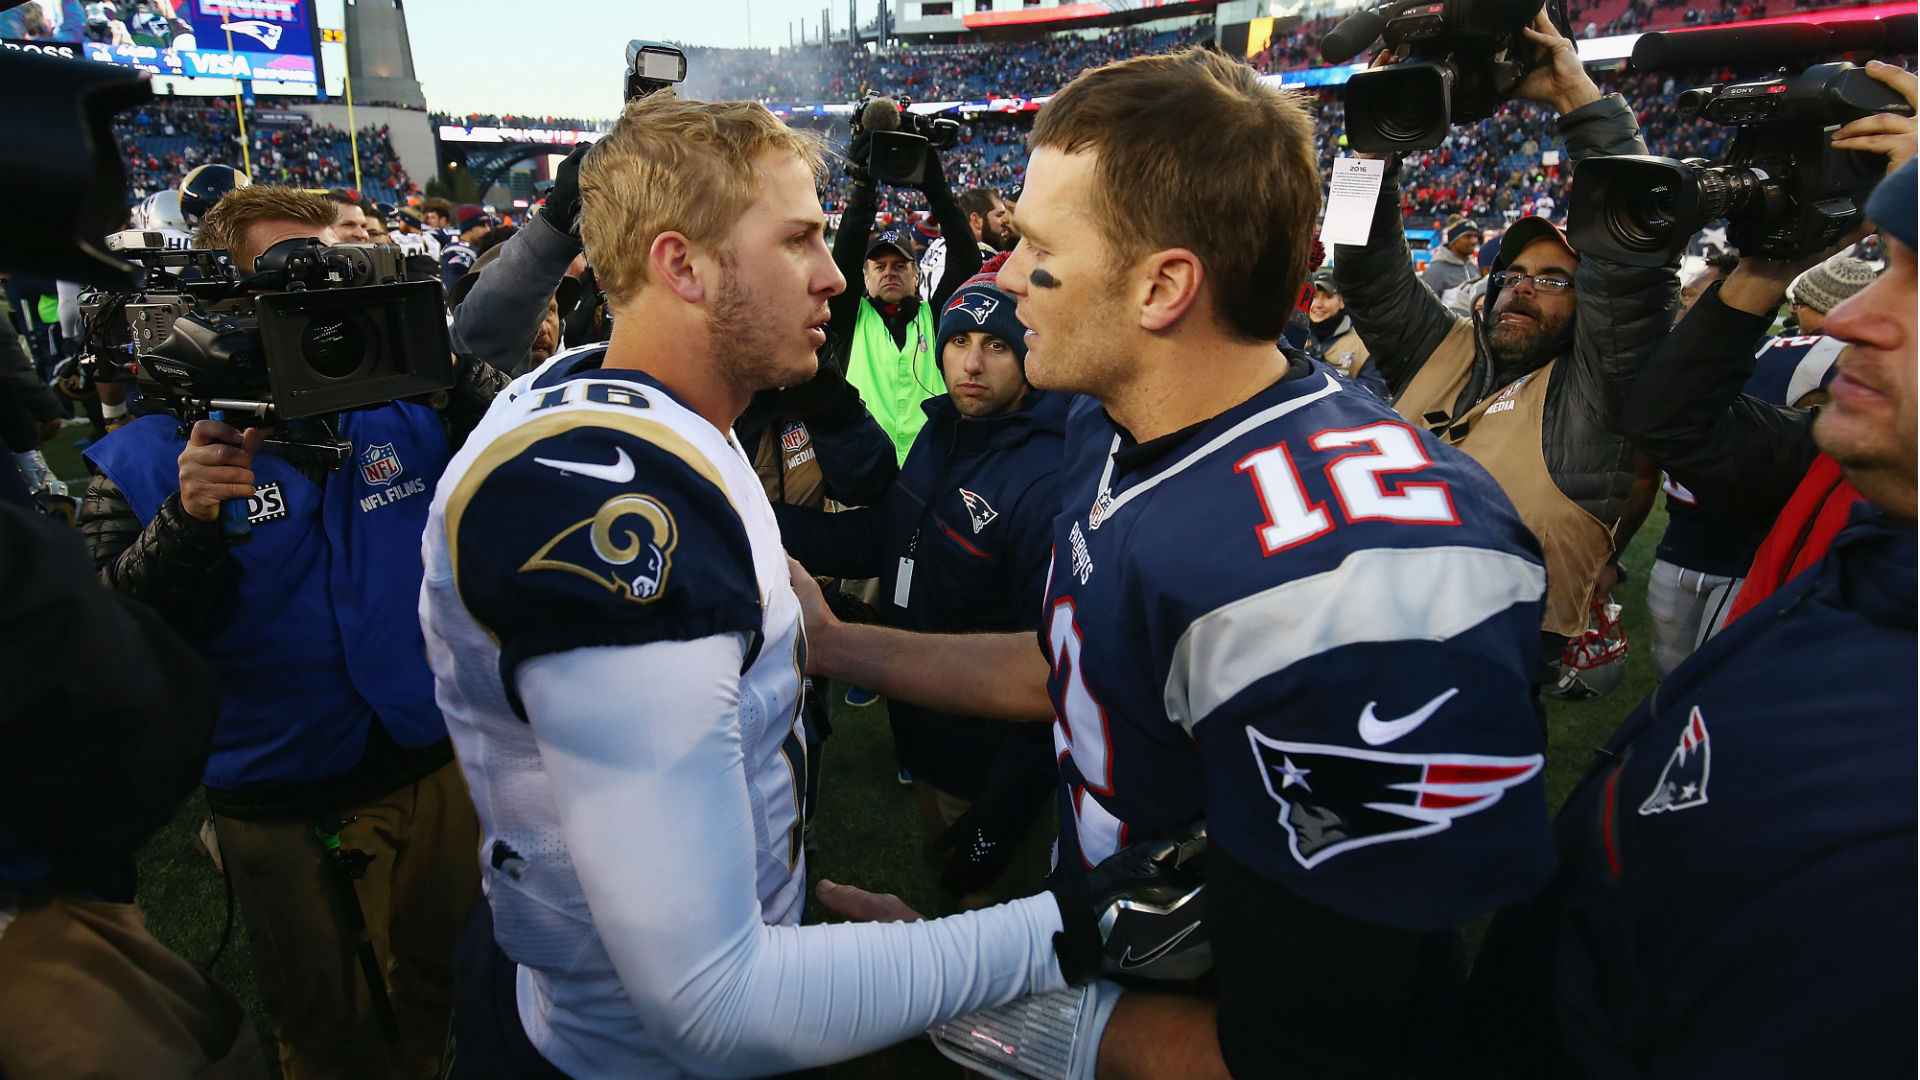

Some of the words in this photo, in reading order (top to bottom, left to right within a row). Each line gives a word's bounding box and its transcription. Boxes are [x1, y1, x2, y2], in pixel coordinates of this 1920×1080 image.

[185, 52, 251, 76] VISA
[1729, 87, 1754, 95] SONY
[527, 384, 654, 414] 16
[1484, 400, 1515, 416] MEDIA
[783, 430, 806, 449] NFL
[364, 458, 398, 481] NFL
[786, 447, 816, 470] MEDIA
[359, 492, 388, 513] NFL
[384, 477, 426, 503] FILMS
[1233, 420, 1463, 558] 12
[1068, 520, 1094, 585] PATRIOTS
